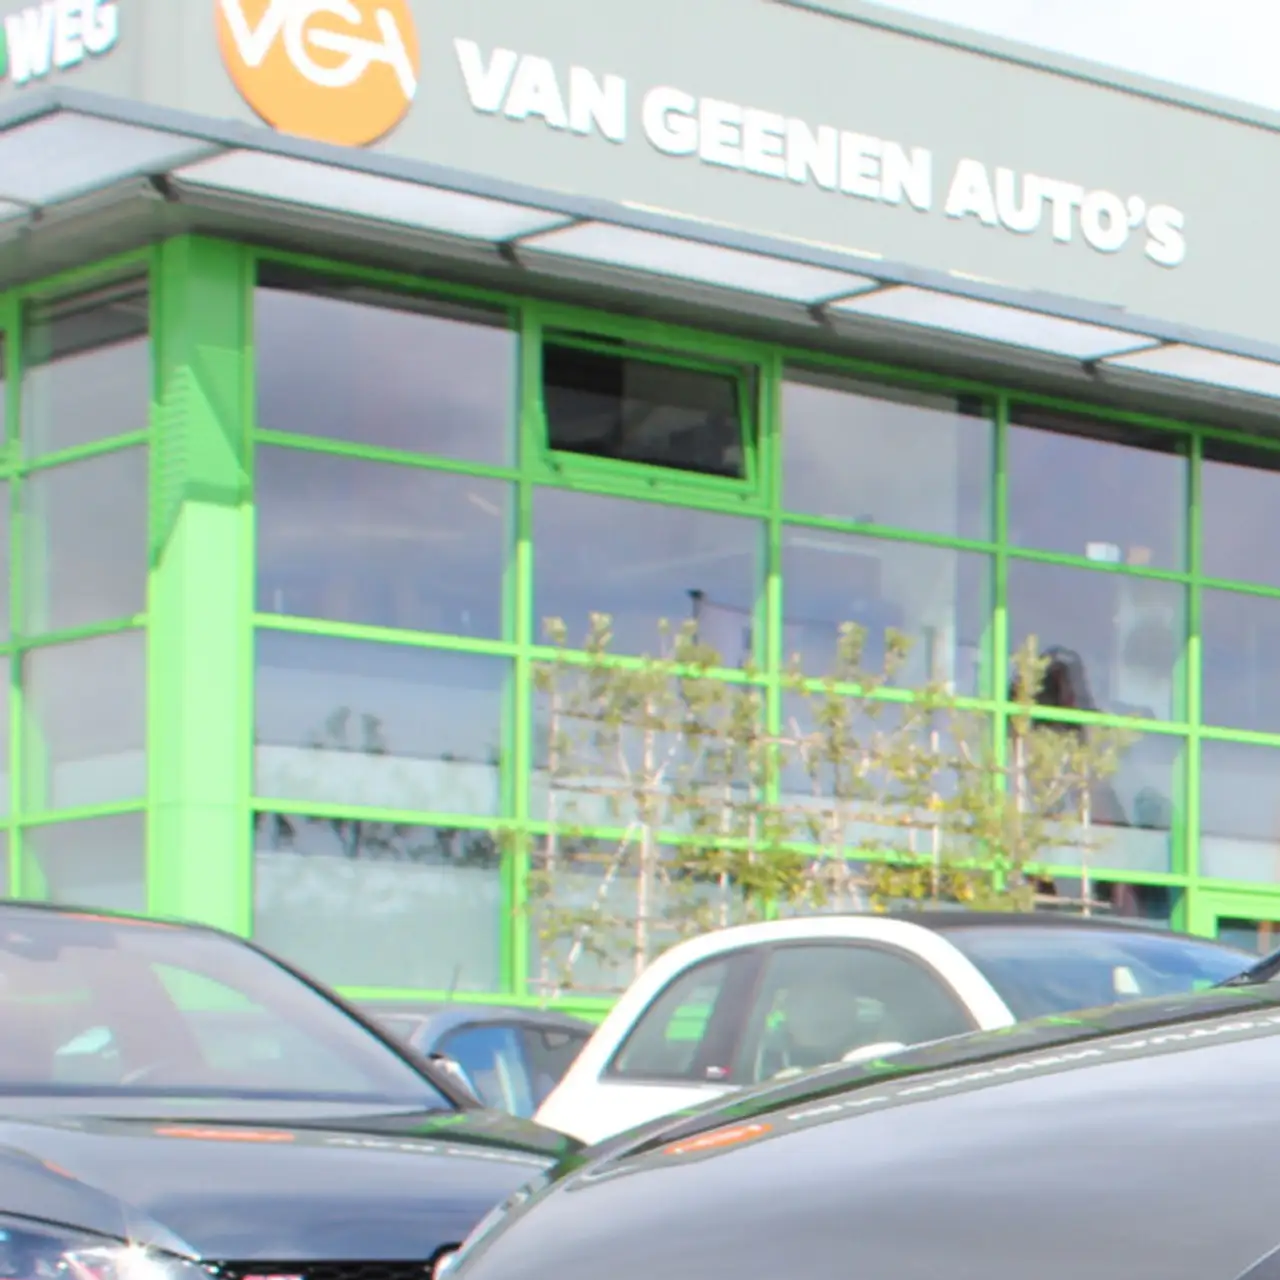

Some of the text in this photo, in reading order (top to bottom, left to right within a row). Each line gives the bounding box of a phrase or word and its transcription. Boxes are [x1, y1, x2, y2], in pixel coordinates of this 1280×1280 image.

[453, 37, 1186, 268] VAN GEENEN AUTO'S
